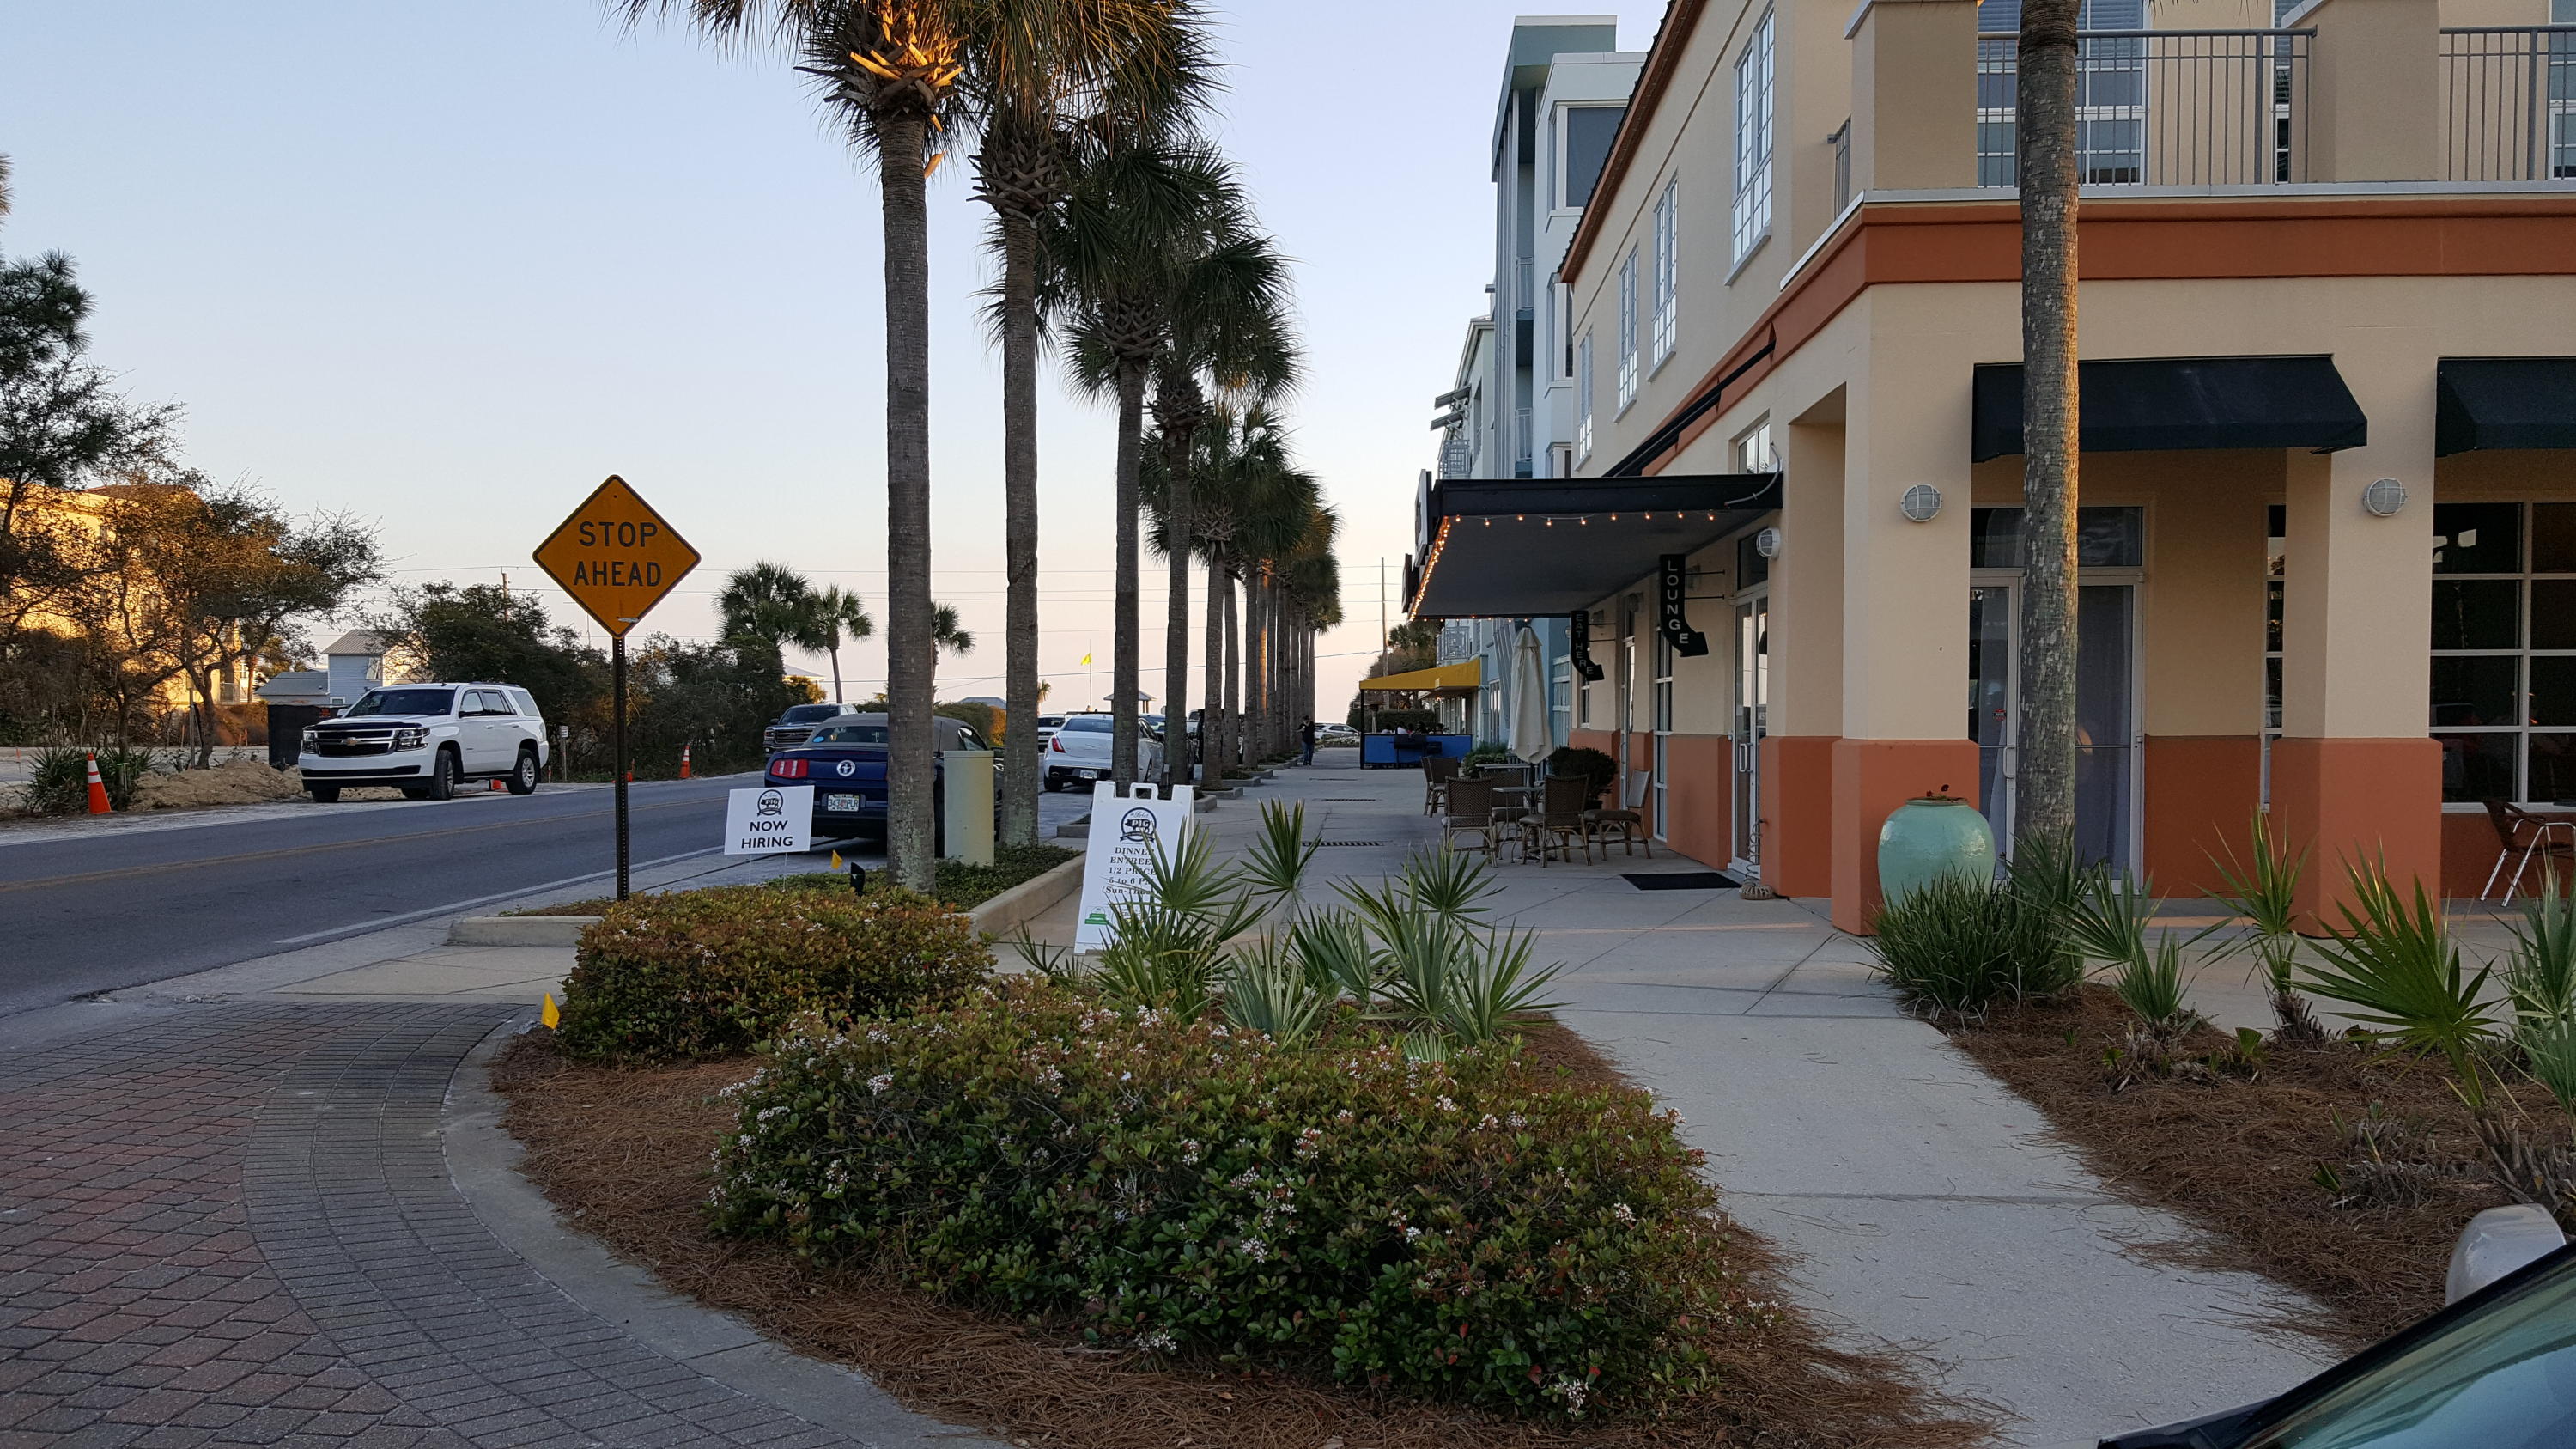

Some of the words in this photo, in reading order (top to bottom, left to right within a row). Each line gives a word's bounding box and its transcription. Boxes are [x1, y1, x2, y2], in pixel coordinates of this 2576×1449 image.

[579, 521, 658, 547] STOP
[574, 561, 661, 587] AHEAD
[1667, 560, 1689, 644] LOUNGE
[1575, 642, 1595, 674] HERE
[750, 820, 788, 831] NOW
[741, 837, 793, 849] HIRING
[1110, 856, 1154, 866] ENTREE
